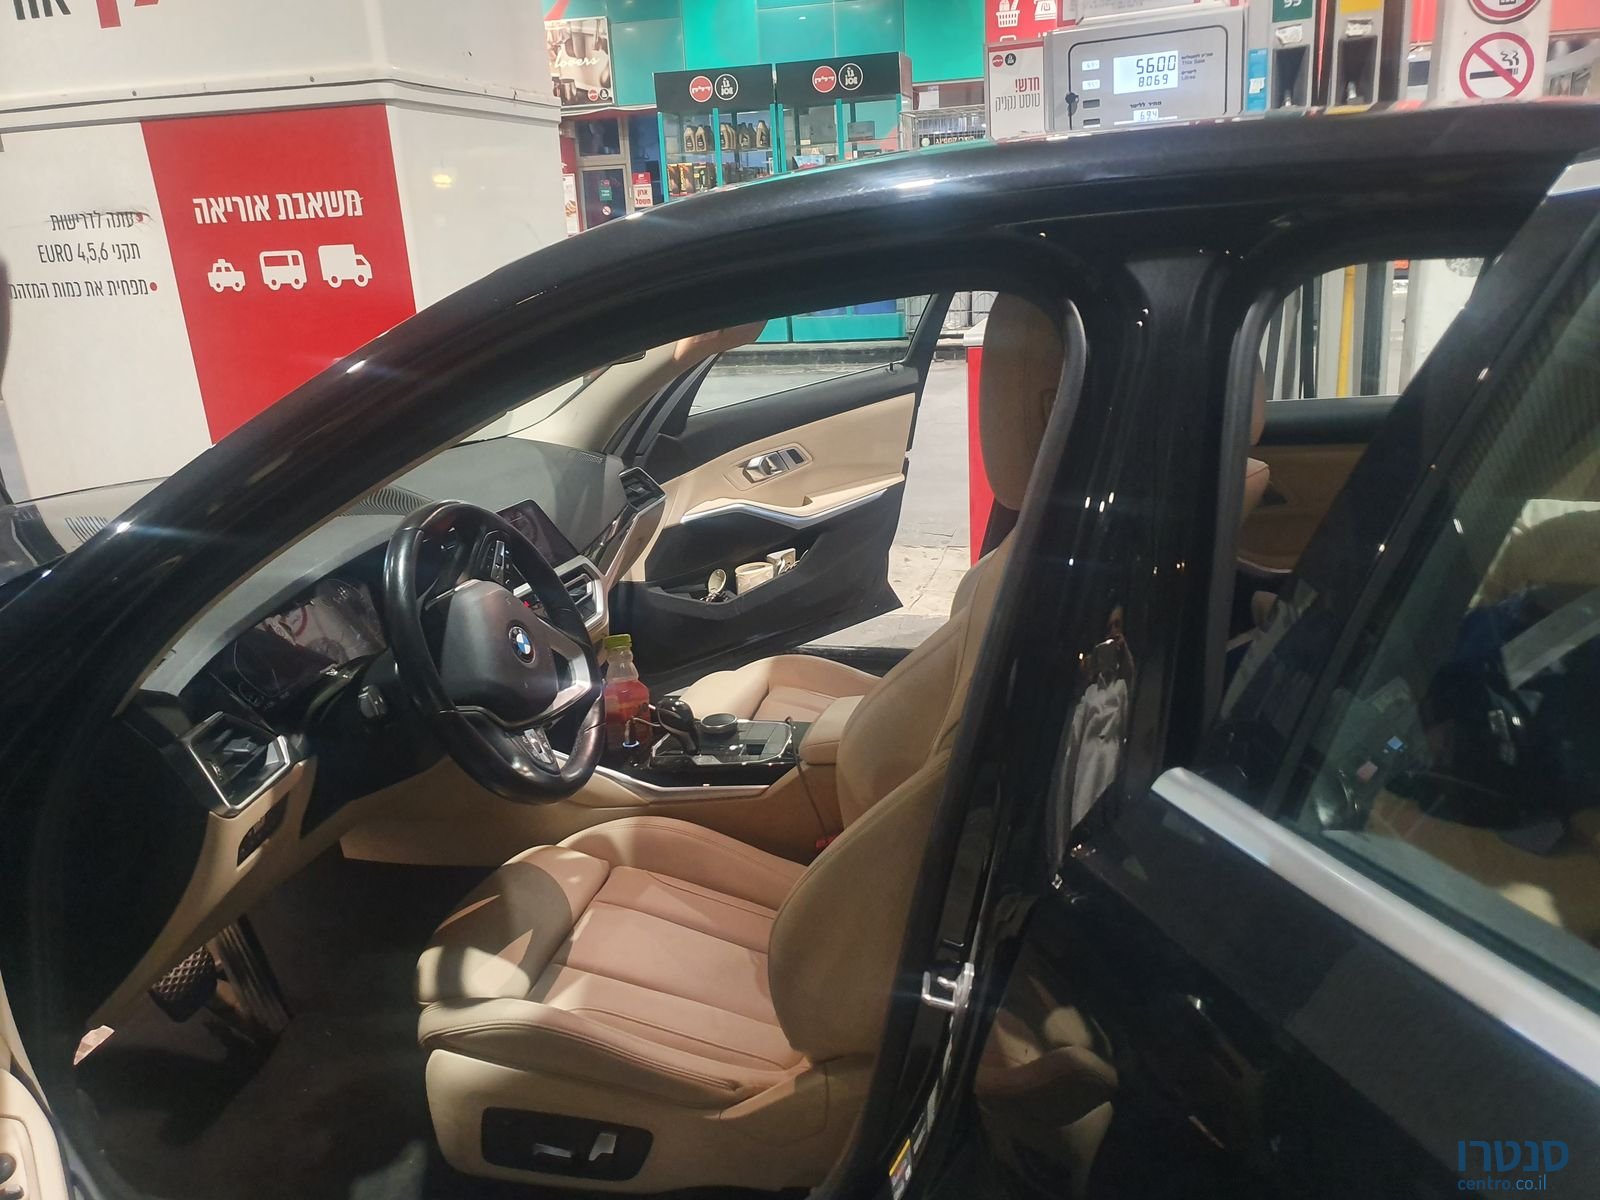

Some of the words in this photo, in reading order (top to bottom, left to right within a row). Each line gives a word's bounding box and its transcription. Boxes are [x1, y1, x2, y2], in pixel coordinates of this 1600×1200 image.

[1015, 76, 1040, 93] חדש!
[995, 95, 1017, 112] נקניק
[1020, 93, 1040, 109] טוסט
[192, 194, 272, 224] אוריאה
[275, 189, 363, 220] משאבת
[50, 211, 101, 231] לדרישות
[37, 243, 73, 263] EURO
[77, 242, 109, 264] 4,5,6
[112, 242, 141, 263] תקני
[52, 281, 82, 298] כמות
[84, 281, 104, 297] את
[107, 278, 149, 296] מפחית
